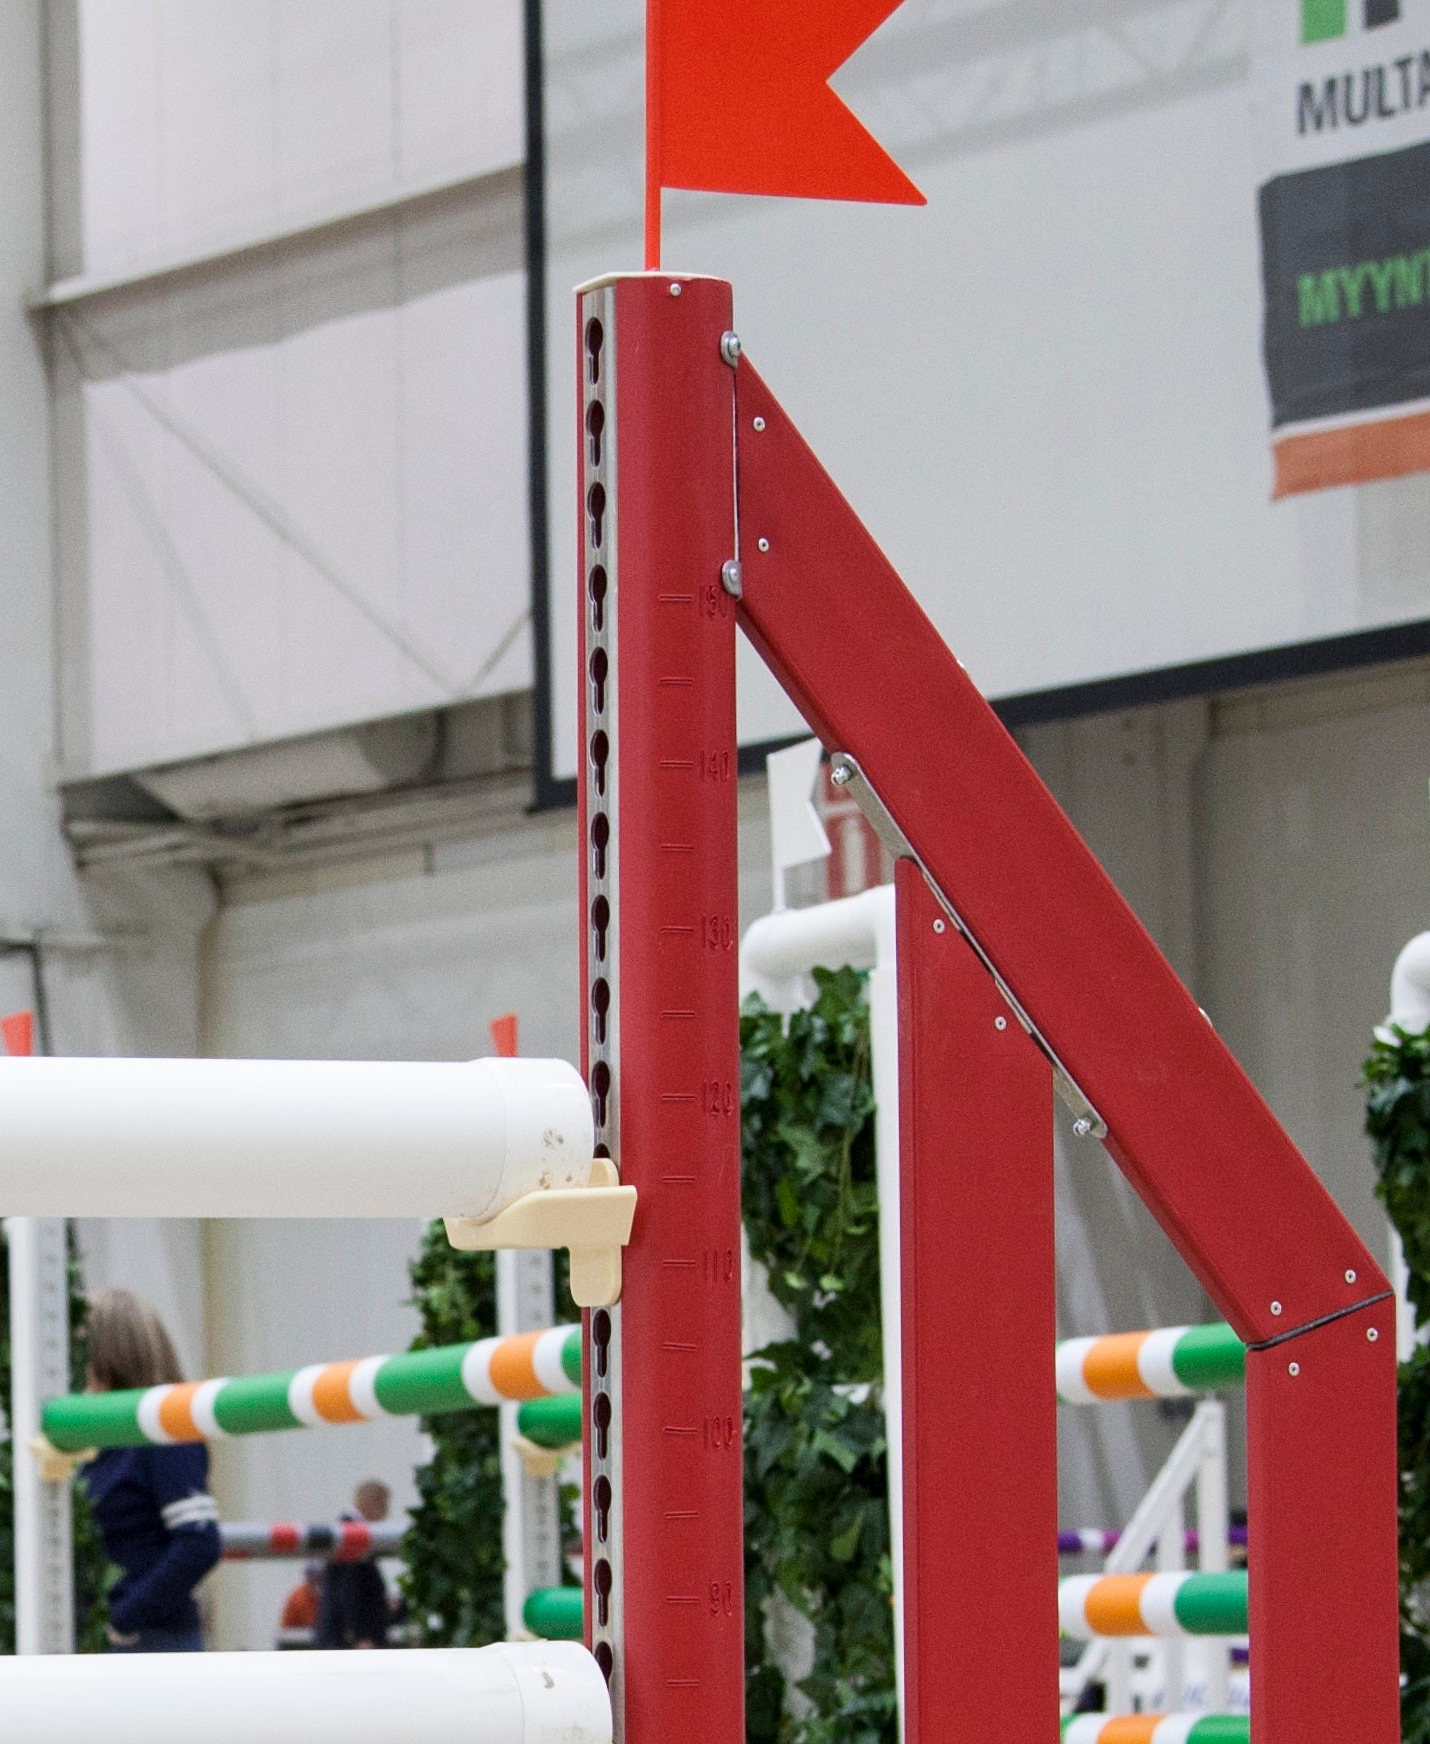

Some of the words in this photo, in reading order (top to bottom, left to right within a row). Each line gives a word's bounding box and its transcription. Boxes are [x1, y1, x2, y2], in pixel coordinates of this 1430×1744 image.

[699, 750, 730, 783] 140
[701, 914, 732, 949] 130
[702, 1079, 733, 1116] 120
[703, 1416, 734, 1450] 100
[710, 1581, 732, 1617] 90
